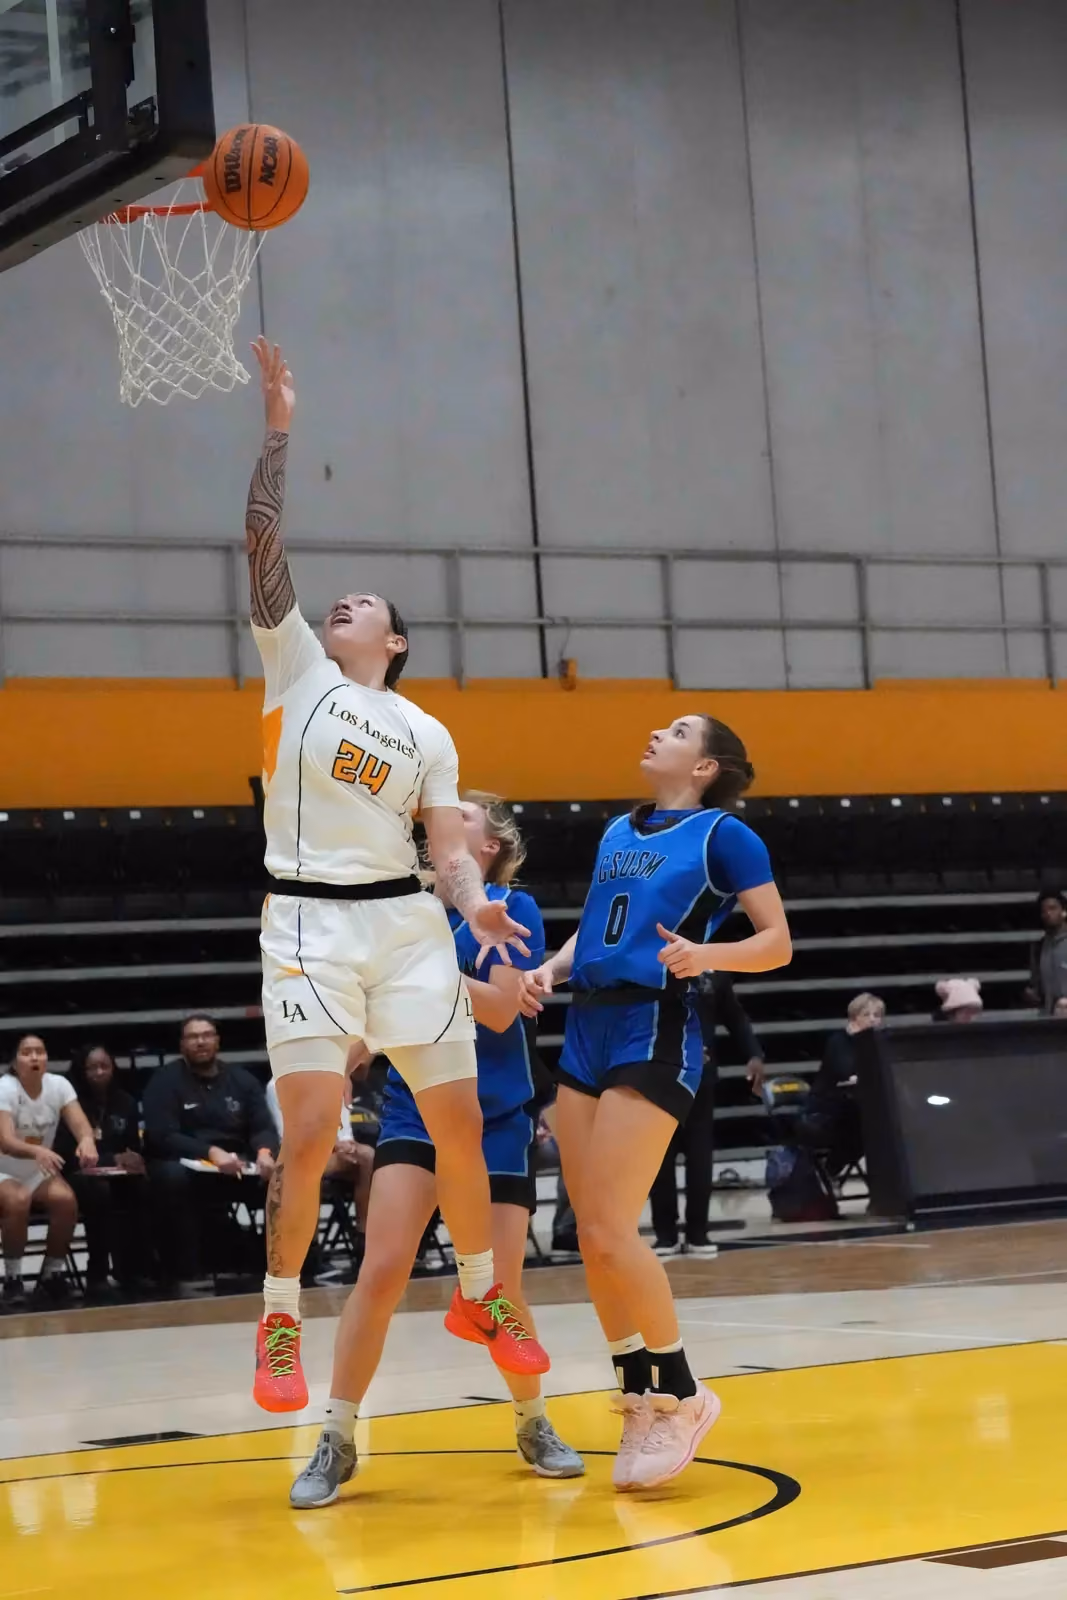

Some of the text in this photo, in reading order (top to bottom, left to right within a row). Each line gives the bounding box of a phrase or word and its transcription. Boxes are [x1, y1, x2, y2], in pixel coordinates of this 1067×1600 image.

[259, 136, 278, 187] NCAA
[328, 701, 415, 759] Los Angeles
[331, 738, 392, 796] 24
[598, 850, 668, 884] CSUSM
[603, 892, 630, 947] 0
[281, 999, 309, 1023] LA
